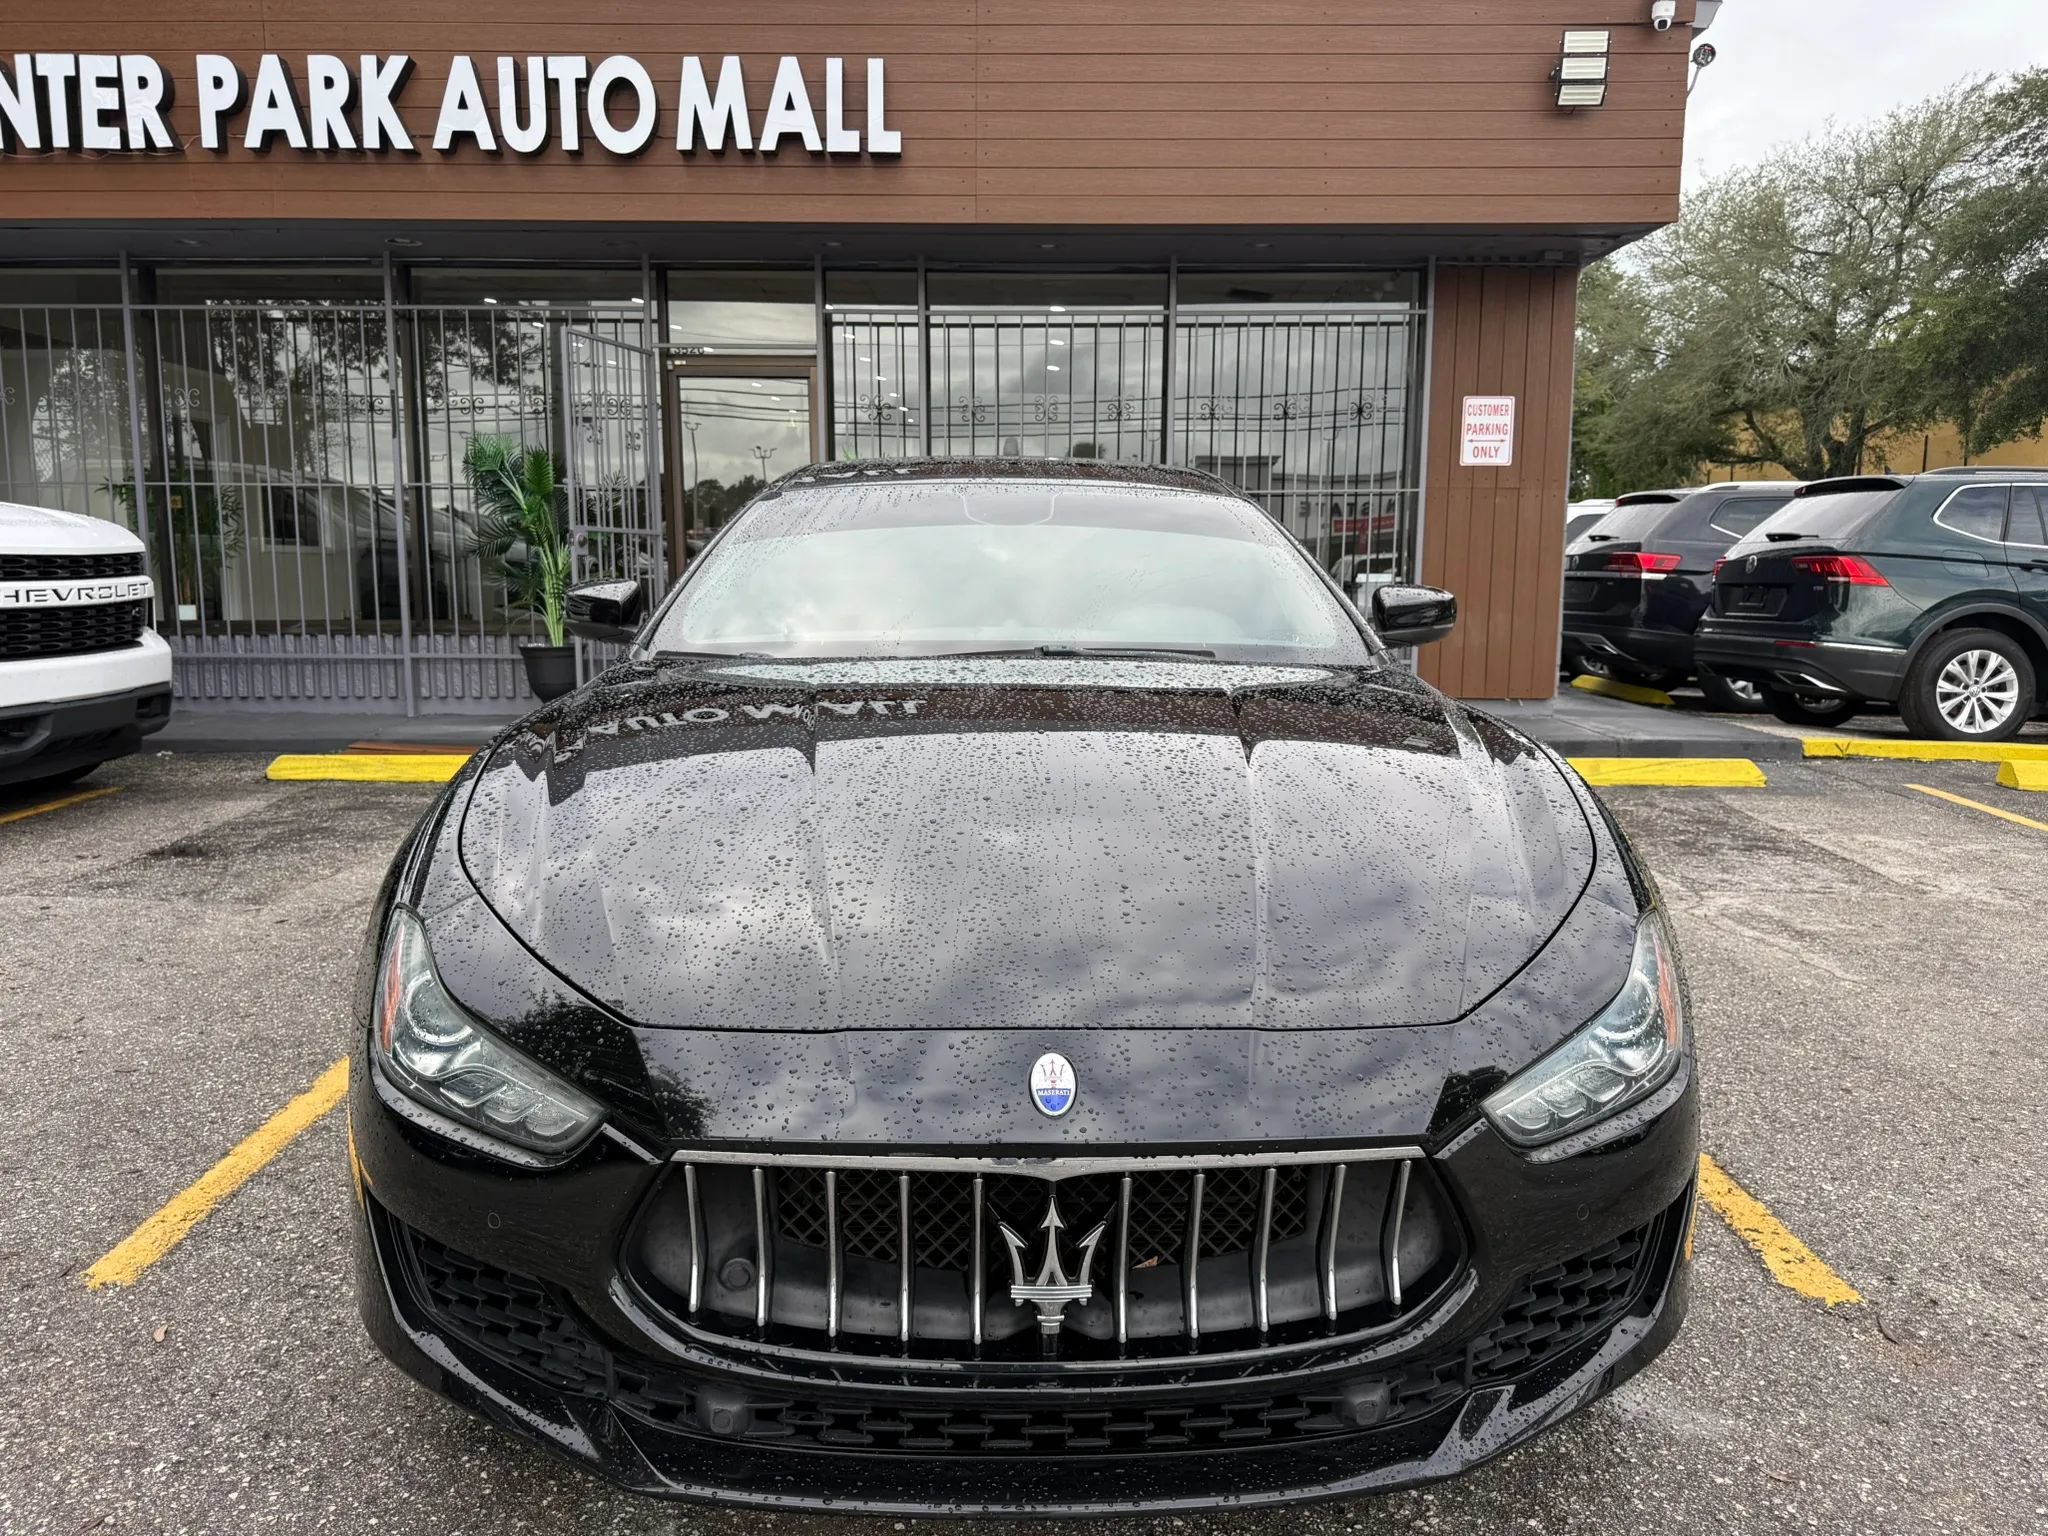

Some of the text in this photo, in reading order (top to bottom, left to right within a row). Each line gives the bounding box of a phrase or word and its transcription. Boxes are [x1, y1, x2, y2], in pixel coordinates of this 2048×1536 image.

[196, 53, 414, 149] PARK
[432, 54, 657, 154] AUTO
[676, 55, 902, 153] MALL
[1467, 404, 1510, 417] CUSTOMER
[1466, 423, 1509, 436] PARKING
[1472, 446, 1501, 459] ONLY
